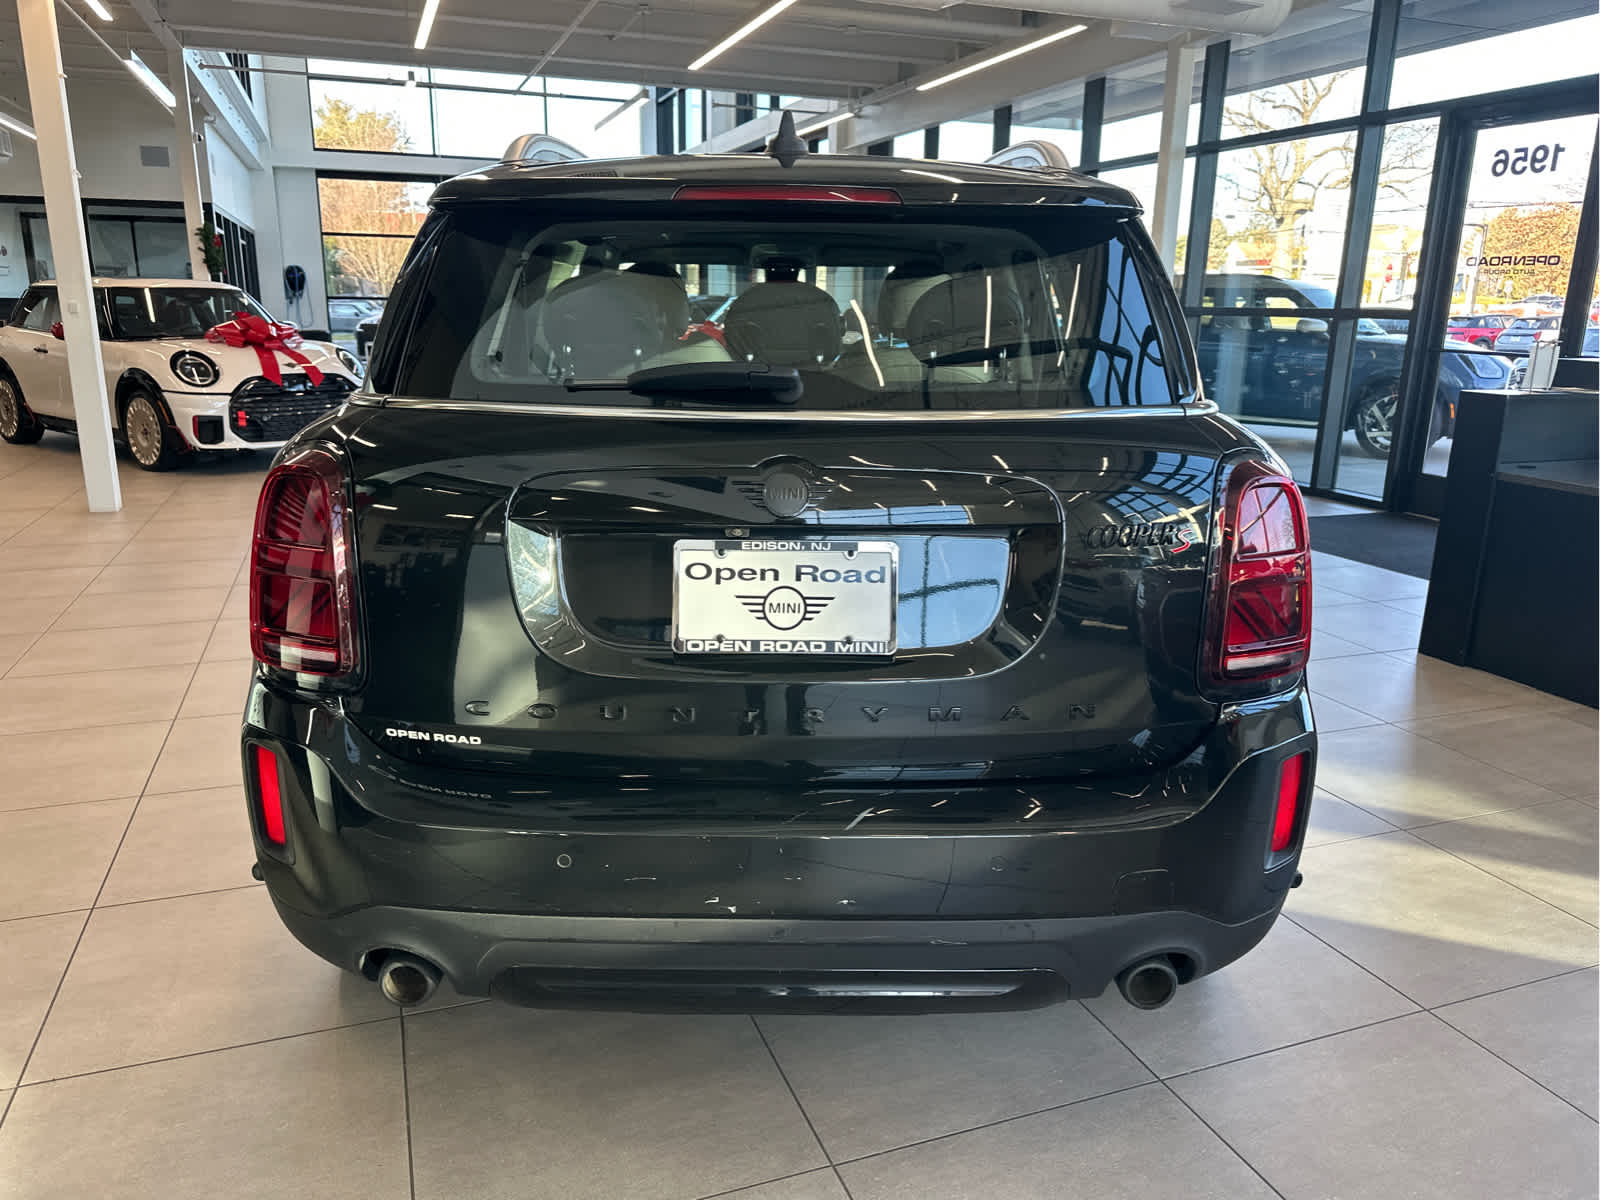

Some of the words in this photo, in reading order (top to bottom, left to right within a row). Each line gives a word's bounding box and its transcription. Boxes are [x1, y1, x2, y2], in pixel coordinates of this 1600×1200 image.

[768, 487, 806, 500] MINI
[741, 541, 805, 551] EDISON,
[811, 541, 832, 551] NJ
[685, 562, 780, 585] Open
[795, 564, 886, 584] Road
[768, 602, 802, 614] MINI
[687, 640, 751, 653] OPEN
[759, 640, 826, 653] ROAD
[834, 640, 886, 653] MINI
[385, 728, 431, 741] OPEN
[433, 733, 482, 745] ROAD
